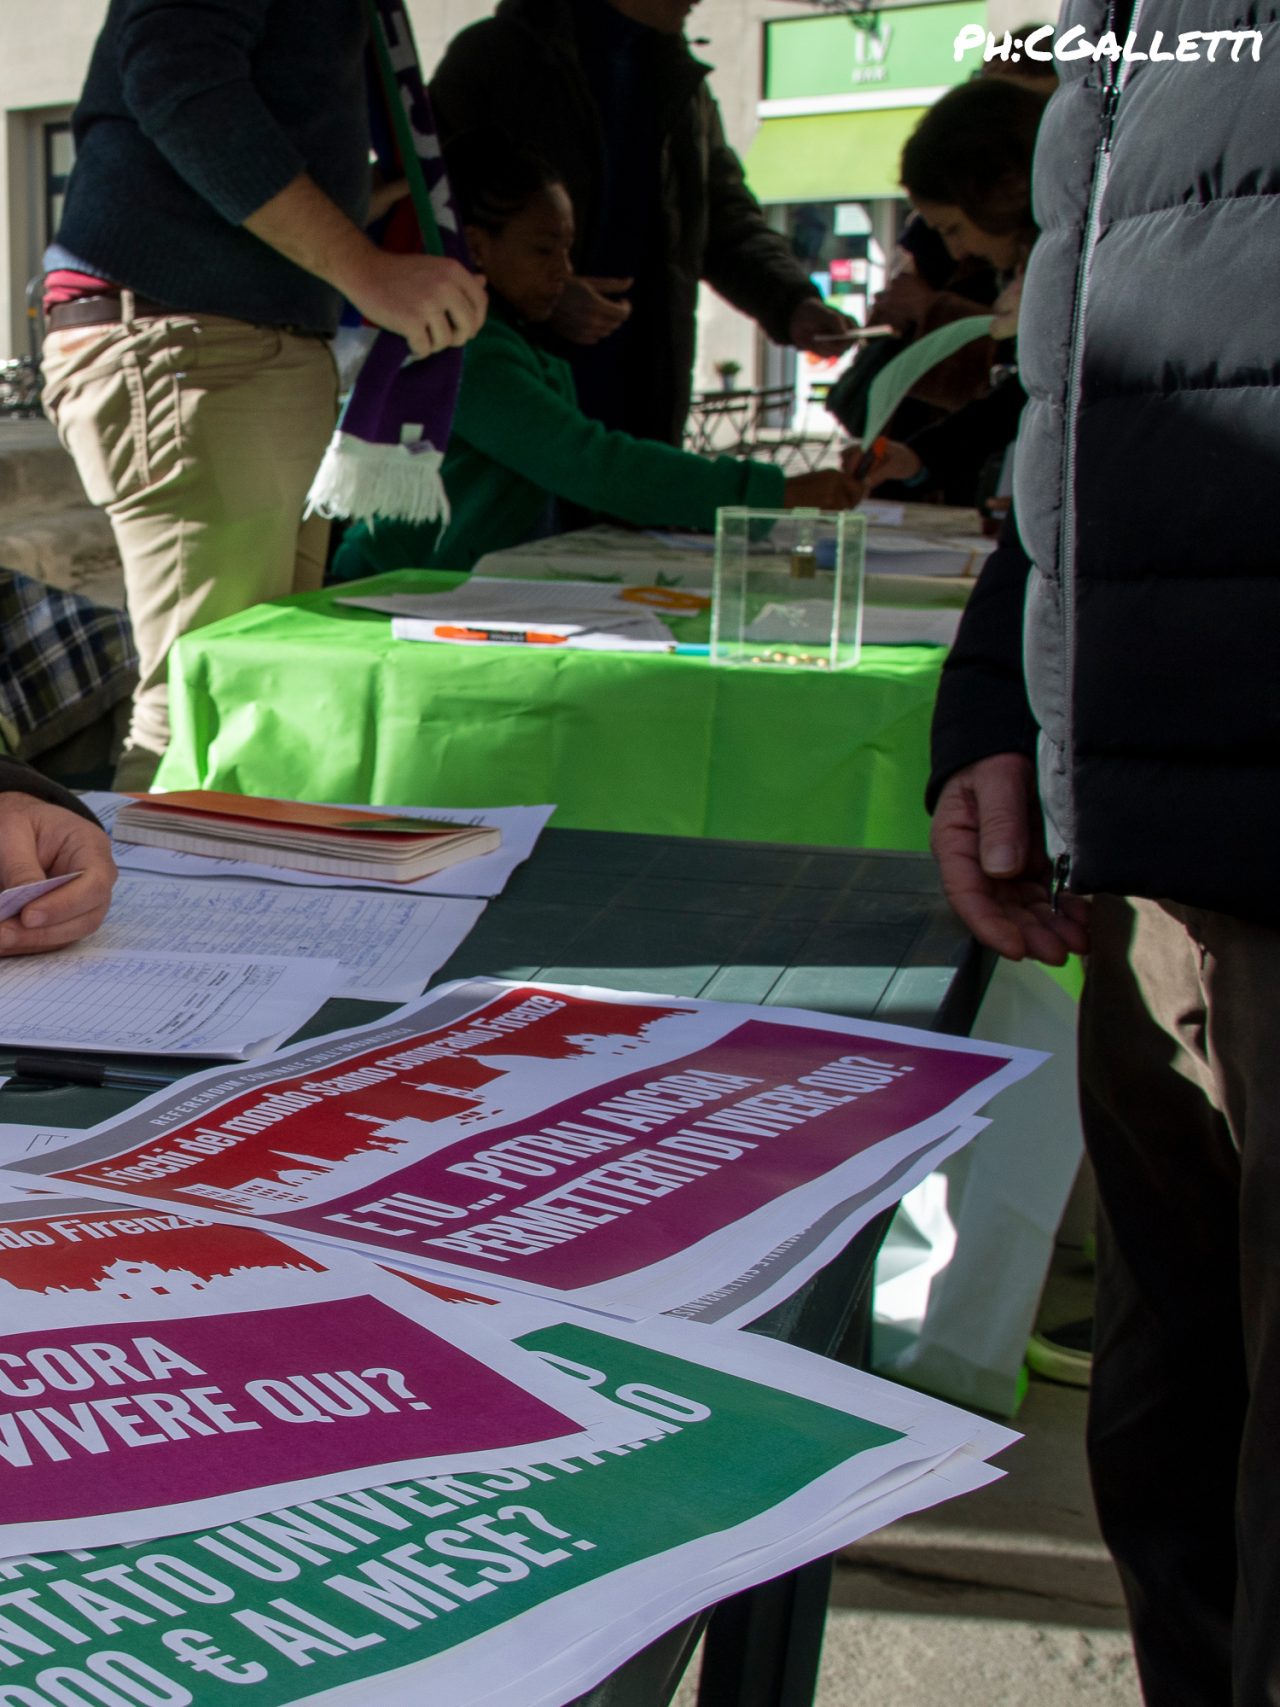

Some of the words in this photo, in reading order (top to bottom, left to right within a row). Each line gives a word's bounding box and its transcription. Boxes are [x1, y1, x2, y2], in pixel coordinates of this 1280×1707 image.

[75, 1172, 114, 1187] I
[102, 1147, 207, 1188] ricchi
[179, 1121, 242, 1157] del
[219, 1084, 322, 1138] mondo
[304, 1062, 398, 1098] stanno
[372, 1019, 505, 1074] comprando
[466, 992, 568, 1036] Firenze
[152, 1079, 239, 1128] REFERENDUM
[239, 1056, 312, 1086] COMUNALE
[307, 1027, 418, 1065] SULL'URBANISTICA
[584, 1068, 766, 1136] ANCORA
[705, 1073, 862, 1144] VIVERE
[798, 1054, 916, 1094] QUI?
[444, 1120, 626, 1190] POTRAI
[655, 1128, 761, 1162] DI
[321, 1211, 418, 1238] E
[360, 1191, 507, 1229] TU...
[421, 1147, 724, 1263] PERMETTERTI
[243, 1366, 433, 1425] QUI?
[160, 1628, 269, 1685] €
[229, 1597, 387, 1667] AL
[322, 1505, 598, 1630] MESE?
